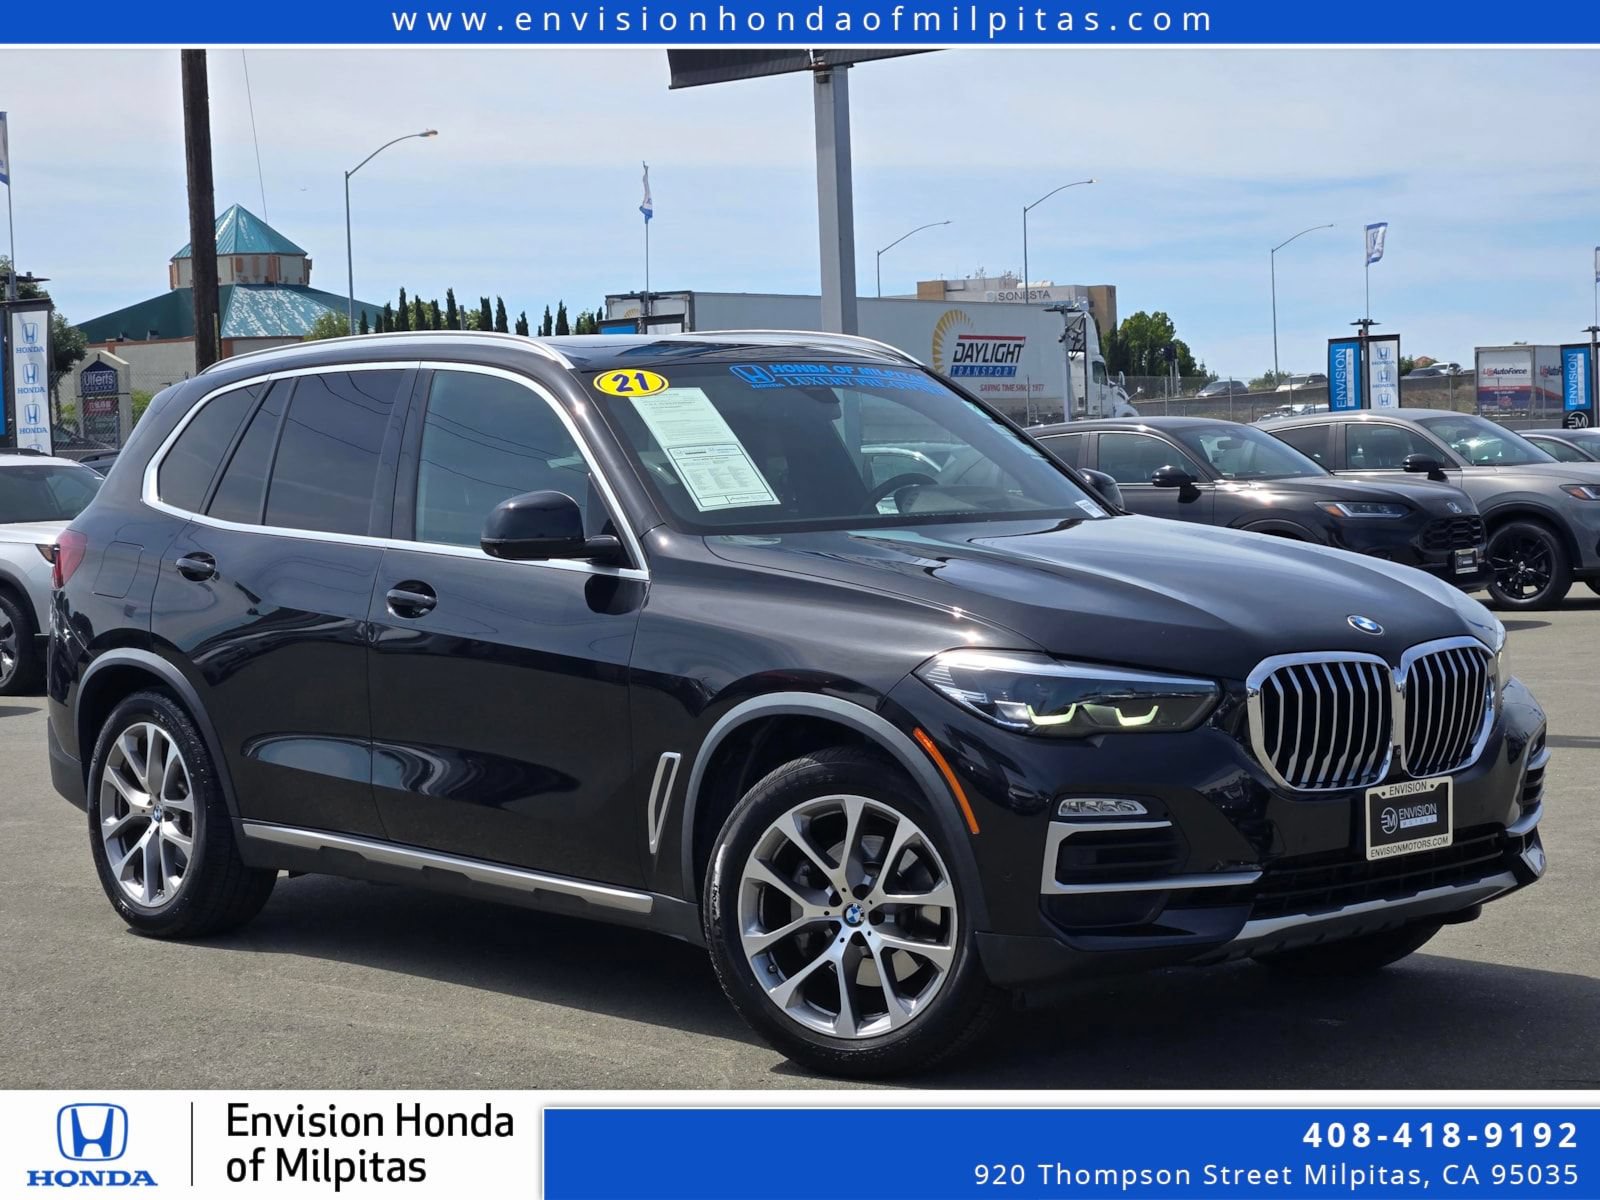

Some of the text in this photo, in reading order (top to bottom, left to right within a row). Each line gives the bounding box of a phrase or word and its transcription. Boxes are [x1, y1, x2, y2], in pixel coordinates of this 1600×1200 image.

[998, 289, 1051, 301] SONESTA
[16, 346, 45, 354] HONDA
[952, 342, 1025, 363] DAYLIGHT
[768, 364, 831, 373] HONDA
[832, 365, 854, 374] OF
[951, 366, 1015, 376] TRANSPORT
[612, 372, 649, 392] 21
[784, 376, 853, 386] LUXURY
[1335, 348, 1346, 408] ENVISION
[1567, 353, 1578, 406] ENVISION
[17, 386, 46, 394] HONDA
[1389, 781, 1427, 796] ENVISION
[1399, 803, 1437, 820] ENVISION
[1370, 836, 1449, 858] ENVISIONMOTORS.COM
